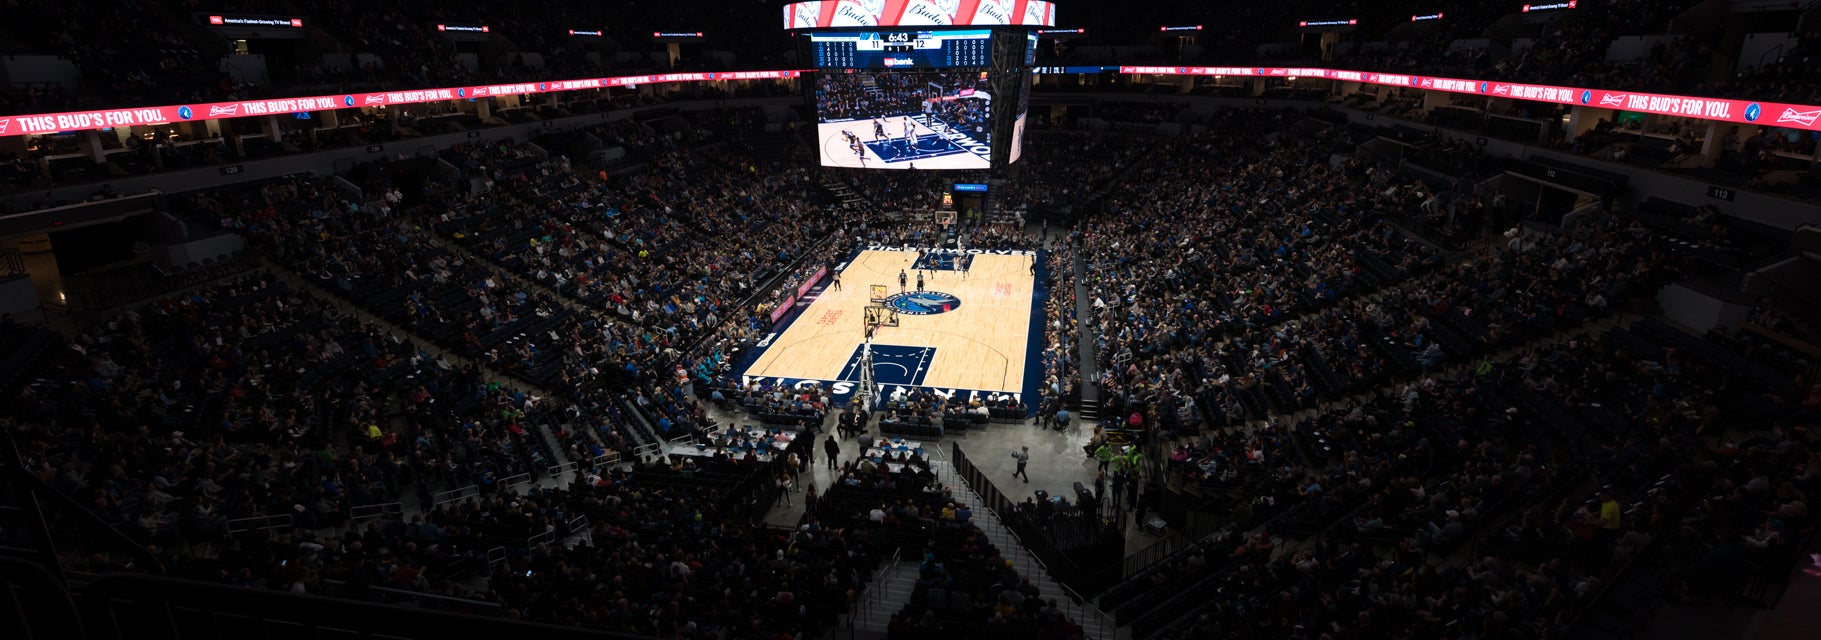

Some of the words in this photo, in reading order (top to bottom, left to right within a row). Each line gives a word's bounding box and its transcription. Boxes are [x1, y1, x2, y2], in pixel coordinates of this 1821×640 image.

[889, 33, 908, 42] 6:43
[388, 93, 404, 102] THIS
[405, 92, 424, 101] BUD'S
[425, 90, 437, 100] FOR
[438, 89, 453, 99] YOU.
[1511, 85, 1524, 96] THIS
[1524, 86, 1542, 99] BUD'S
[1544, 88, 1556, 100] FOR
[1558, 89, 1573, 102] YOU.
[242, 103, 266, 114] THIS
[269, 101, 296, 112] BUD'S
[298, 100, 315, 110] FOR
[316, 98, 336, 108] YOU.
[1628, 95, 1648, 108] THIS
[1649, 97, 1679, 112] BUD'S
[1680, 99, 1703, 115] FOR
[1705, 101, 1730, 118] YOU.
[16, 117, 56, 132] THIS
[58, 113, 103, 128] BUD'S
[106, 111, 133, 125] FOR
[135, 109, 166, 122] YOU.
[1783, 111, 1816, 123] Budweiser
[1547, 169, 1556, 177] 112
[1715, 189, 1729, 199] 113
